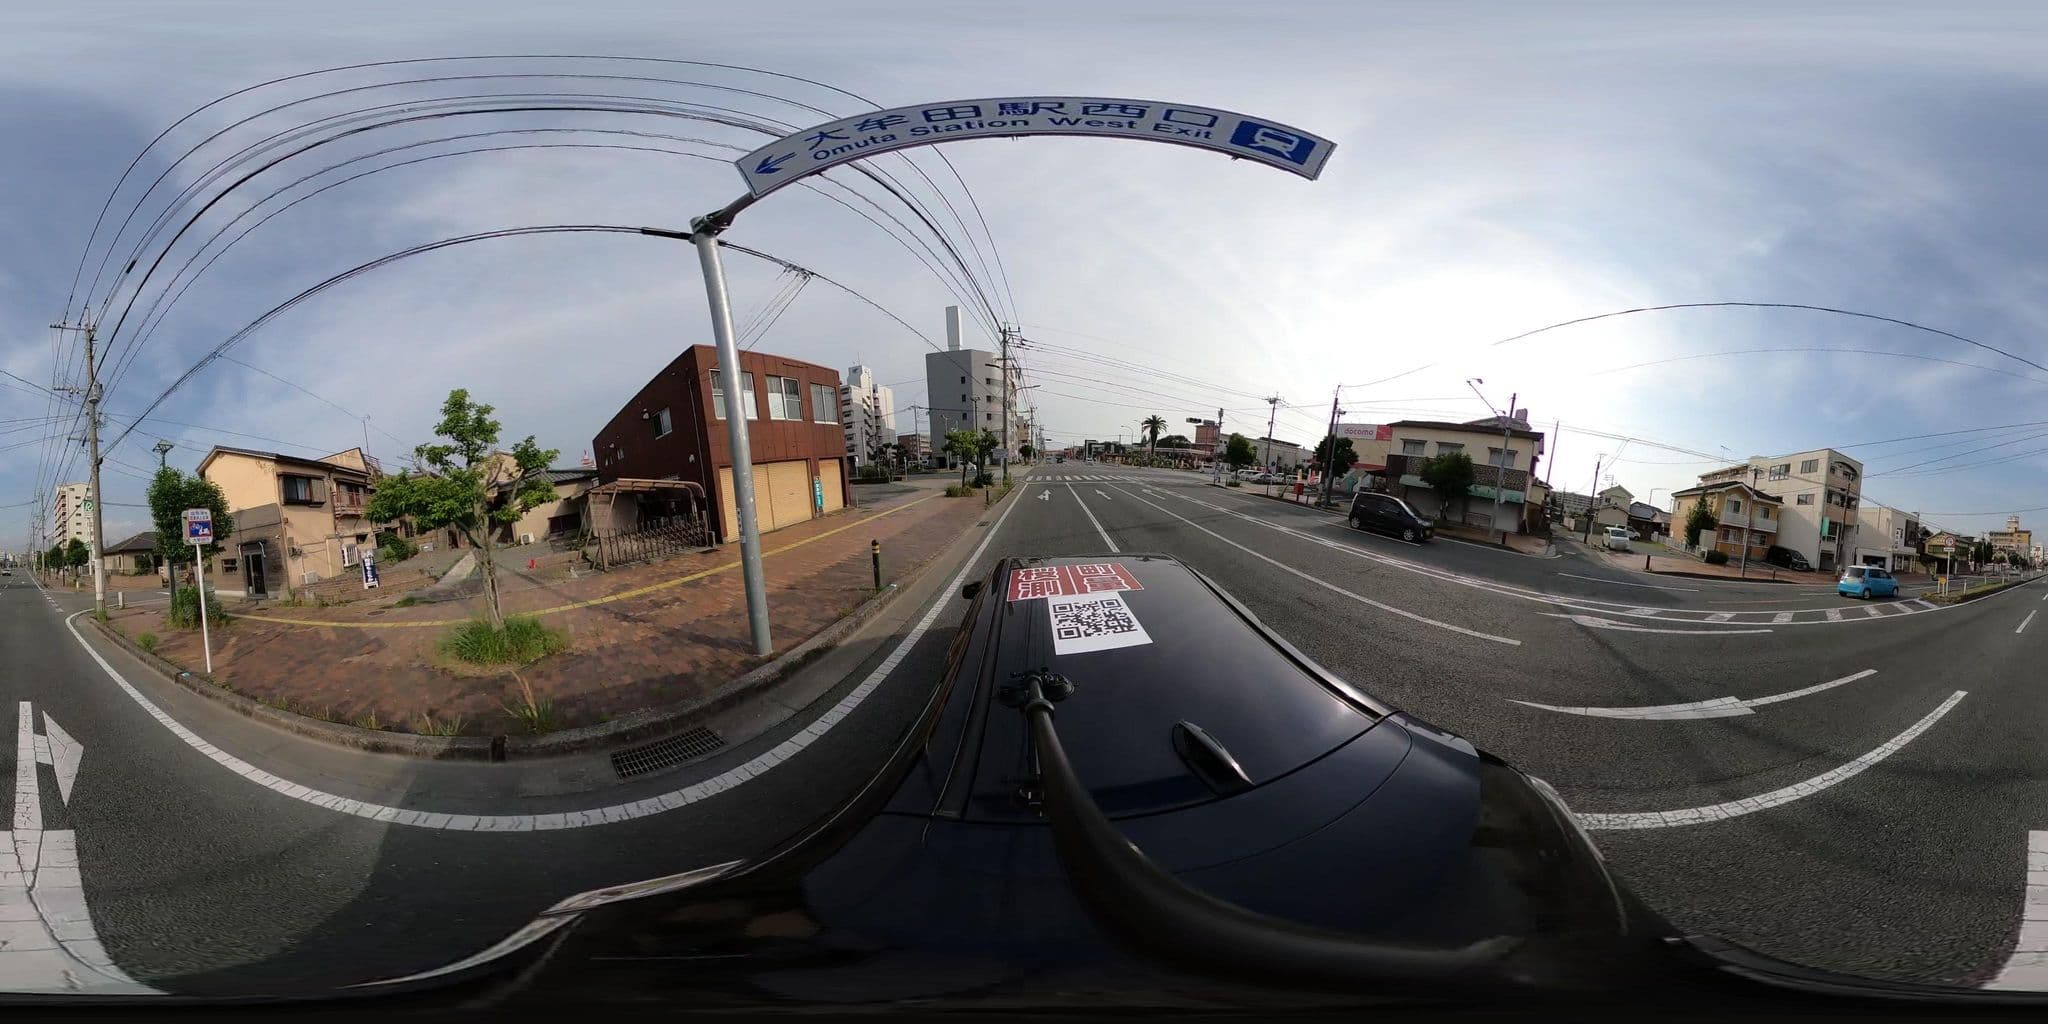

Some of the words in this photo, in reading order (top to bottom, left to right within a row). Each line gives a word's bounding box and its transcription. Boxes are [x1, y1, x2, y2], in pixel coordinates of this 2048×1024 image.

[804, 101, 1219, 151] 大牟田駅西口
[813, 133, 897, 161] Omuta
[909, 118, 1030, 137] Station
[1048, 117, 1137, 128] West
[1153, 122, 1213, 139] Exit
[1344, 427, 1373, 436] docomo
